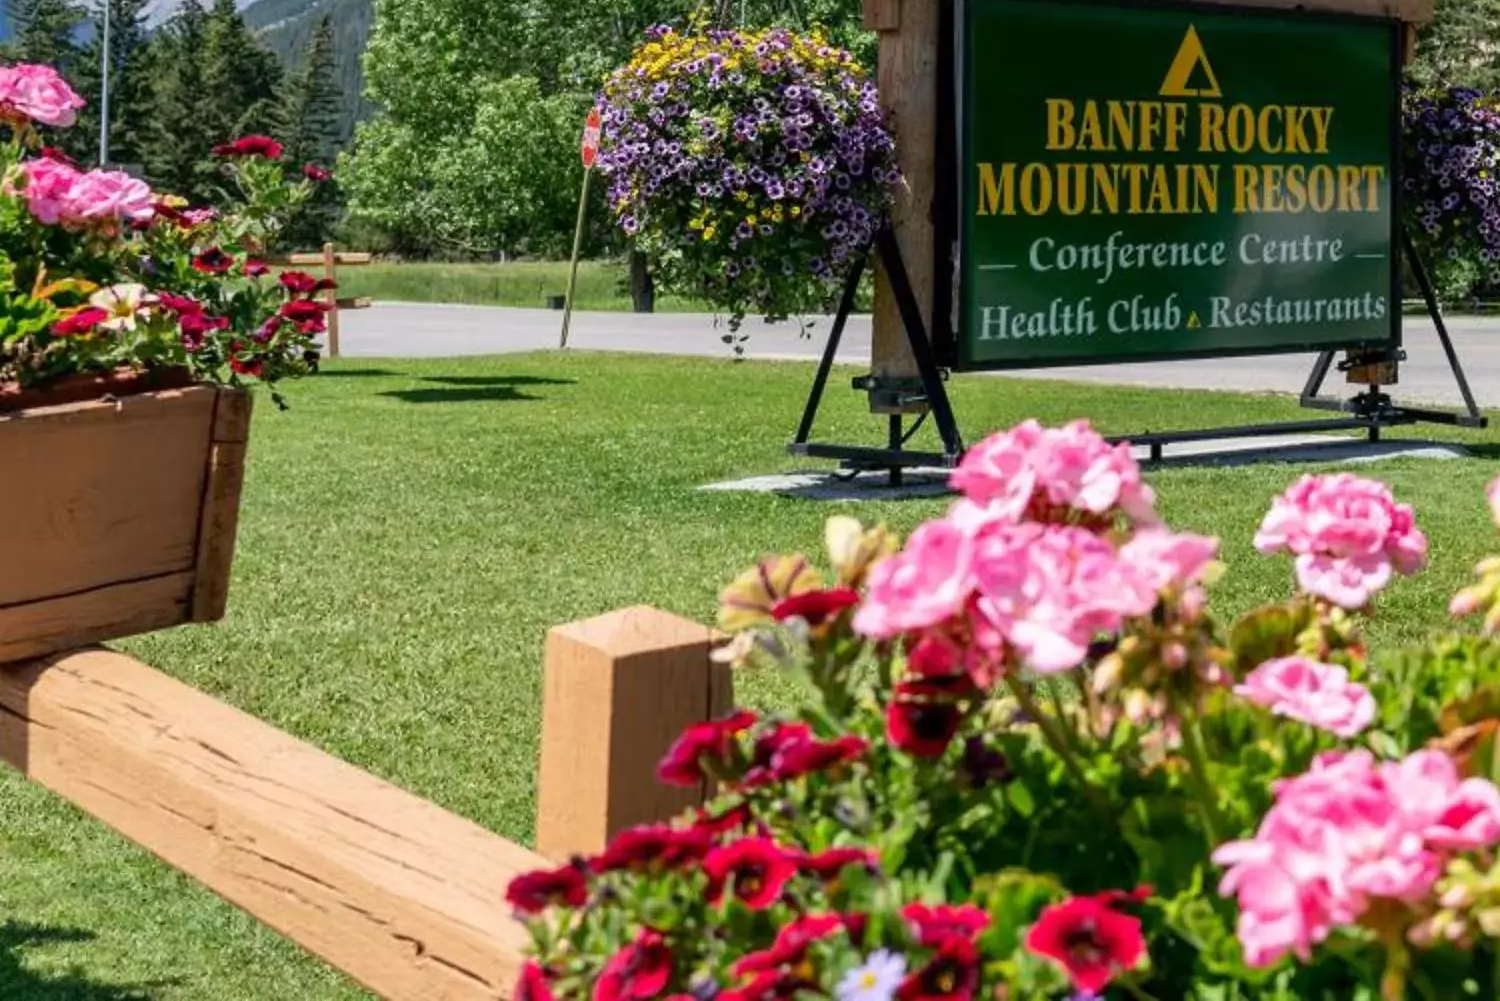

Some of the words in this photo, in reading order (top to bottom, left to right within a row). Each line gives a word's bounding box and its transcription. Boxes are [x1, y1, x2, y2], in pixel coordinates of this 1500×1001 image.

[1045, 98, 1188, 152] BANFF
[1198, 103, 1333, 154] ROCKY
[976, 163, 1220, 216] MOUNTAIN
[1233, 164, 1386, 214] RESORT
[1029, 231, 1226, 284] Conference
[1239, 233, 1343, 265] Centre
[978, 297, 1098, 341] Health
[1108, 293, 1181, 333] Club
[1209, 291, 1386, 328] Restaurants
